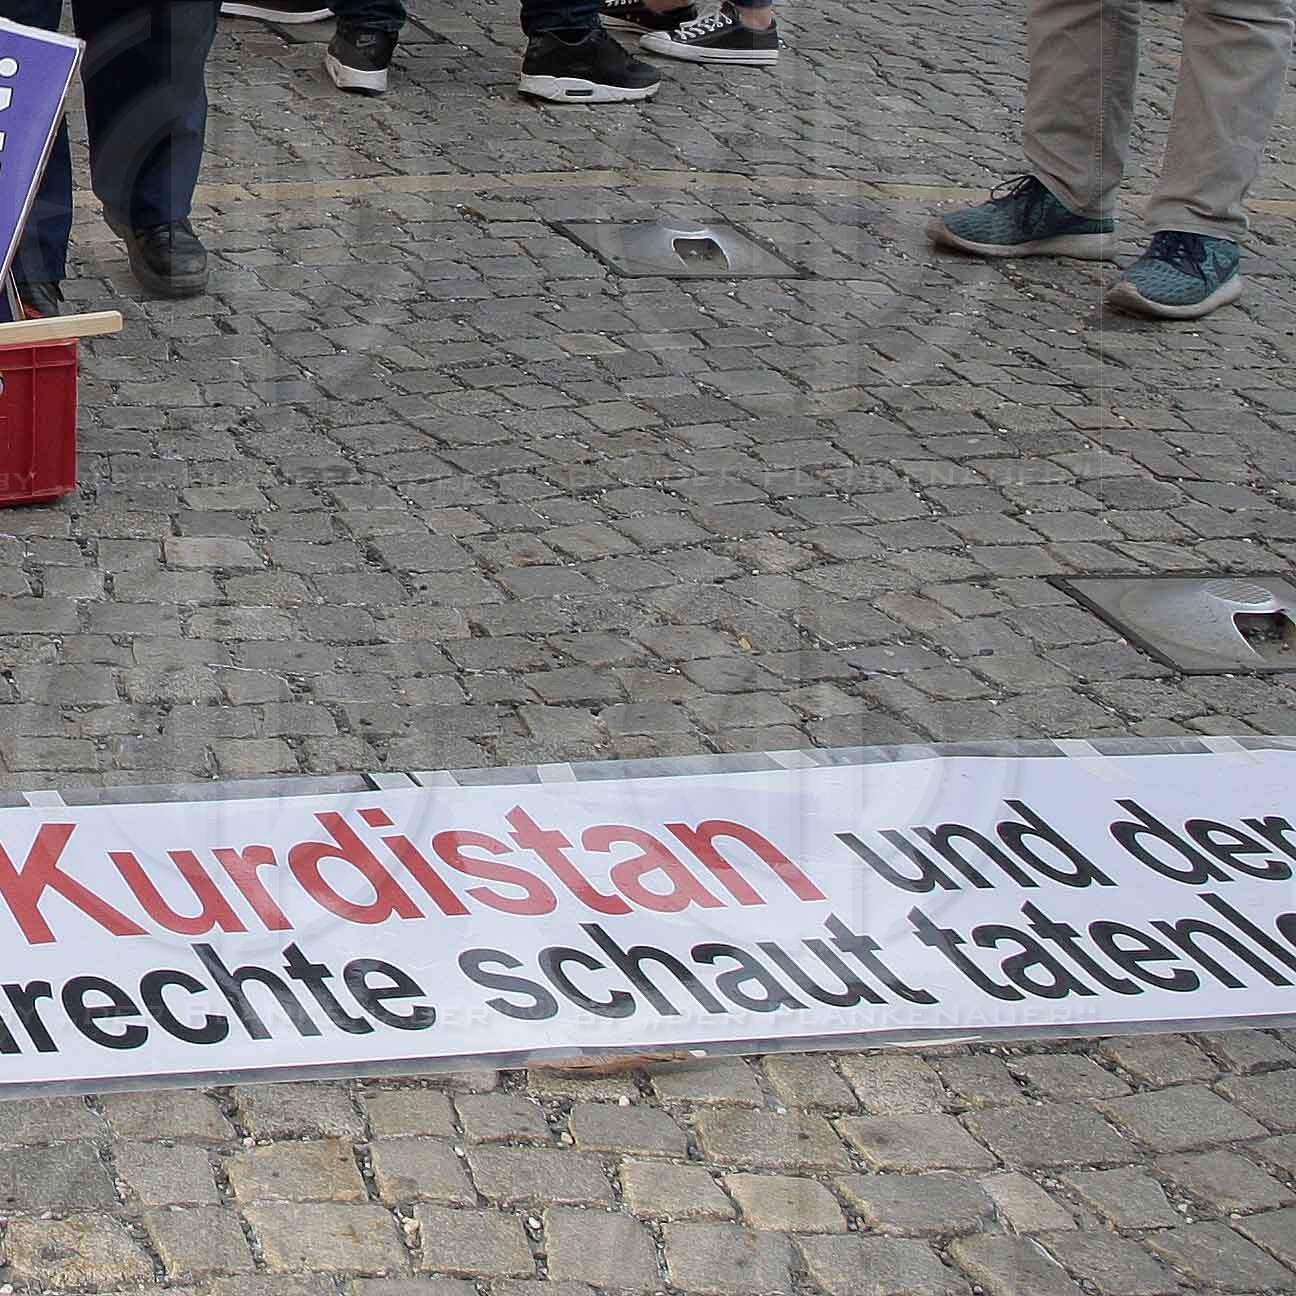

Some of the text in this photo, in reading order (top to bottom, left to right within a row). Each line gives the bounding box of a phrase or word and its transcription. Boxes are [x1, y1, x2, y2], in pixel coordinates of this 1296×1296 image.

[835, 798, 1116, 893] und
[1109, 798, 1296, 885] der
[457, 912, 939, 1022] schaut
